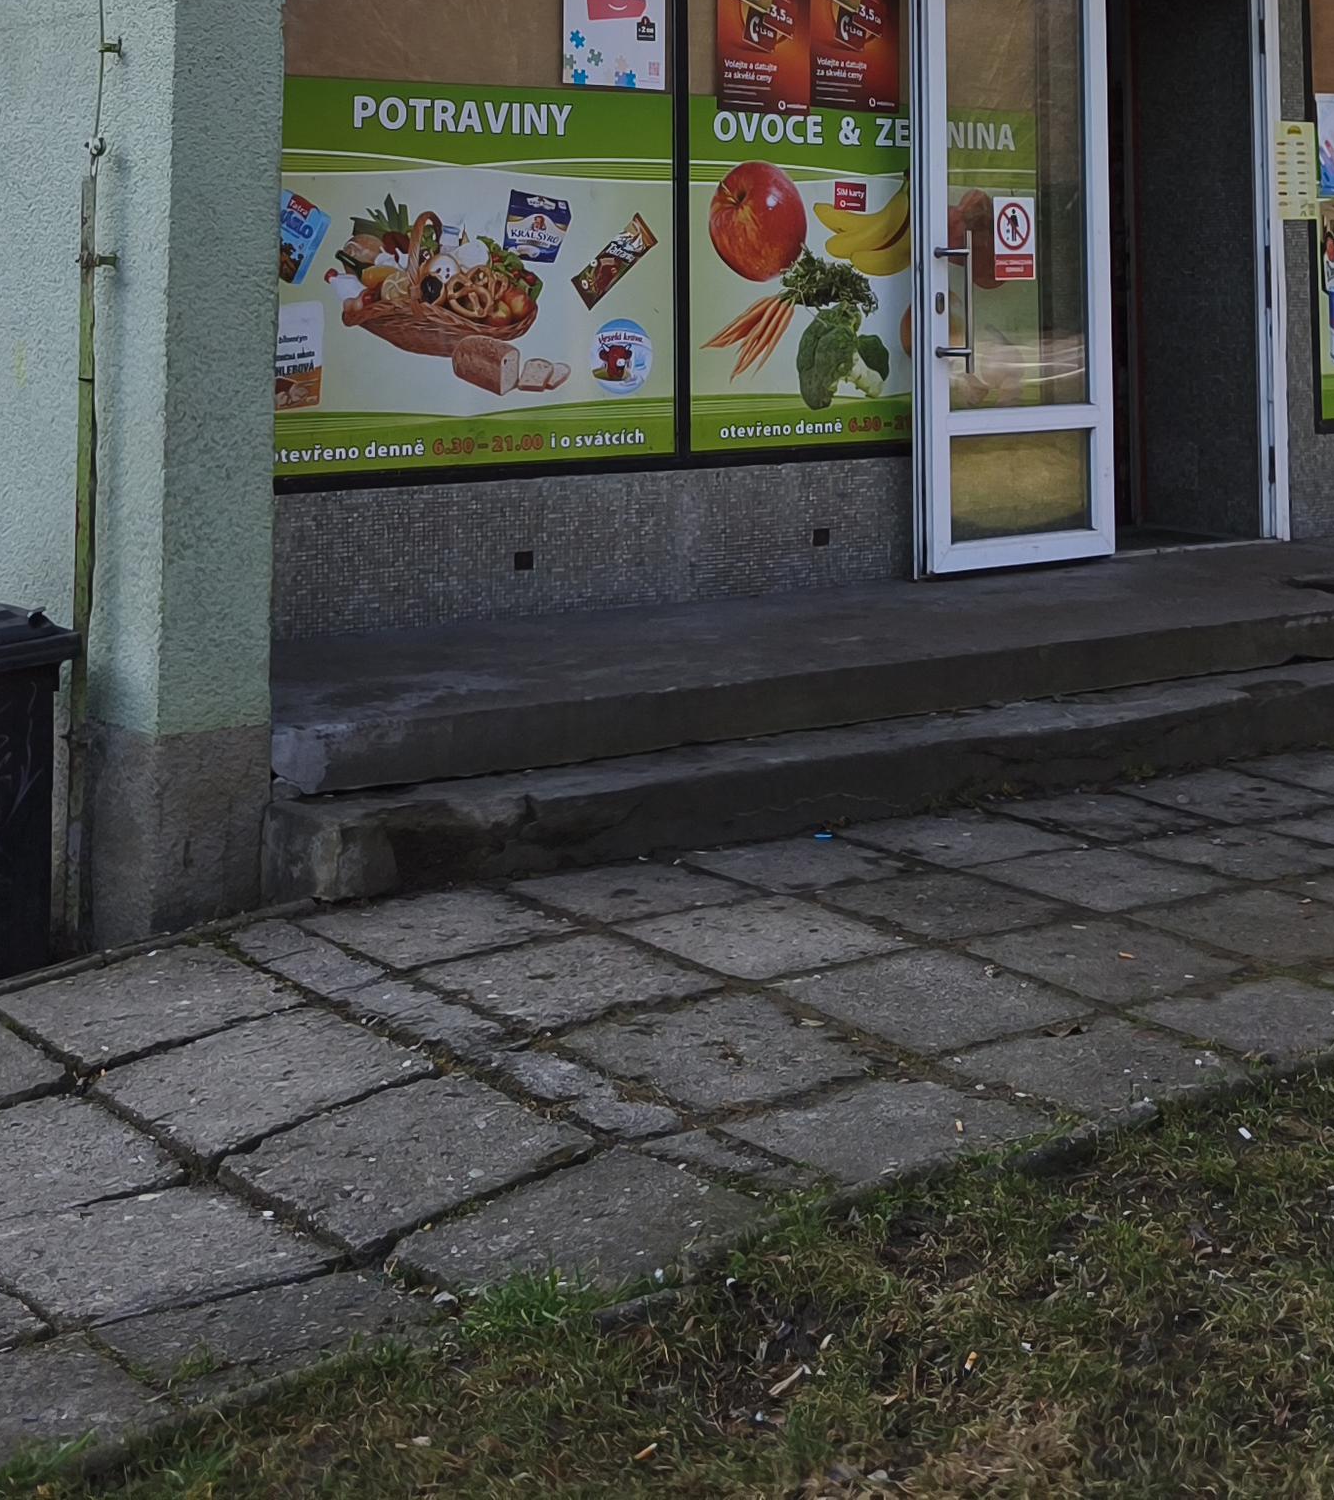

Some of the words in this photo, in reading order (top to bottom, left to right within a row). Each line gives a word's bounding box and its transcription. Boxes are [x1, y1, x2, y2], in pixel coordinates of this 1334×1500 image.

[352, 95, 573, 137] POTRAVINY
[712, 111, 823, 145] OVOCE
[838, 116, 861, 147] &
[836, 187, 848, 196] SIM
[275, 360, 315, 378] HLEBOVÁ
[720, 421, 792, 439] otevřeno
[795, 417, 843, 436] denně
[848, 416, 883, 434] 6.30
[274, 441, 359, 464] tevřeno
[364, 438, 424, 461] denně
[431, 436, 475, 456] 6.30
[491, 434, 544, 453] 21.00
[550, 434, 556, 449] i
[560, 437, 571, 448] o
[574, 428, 645, 447] svátcích
